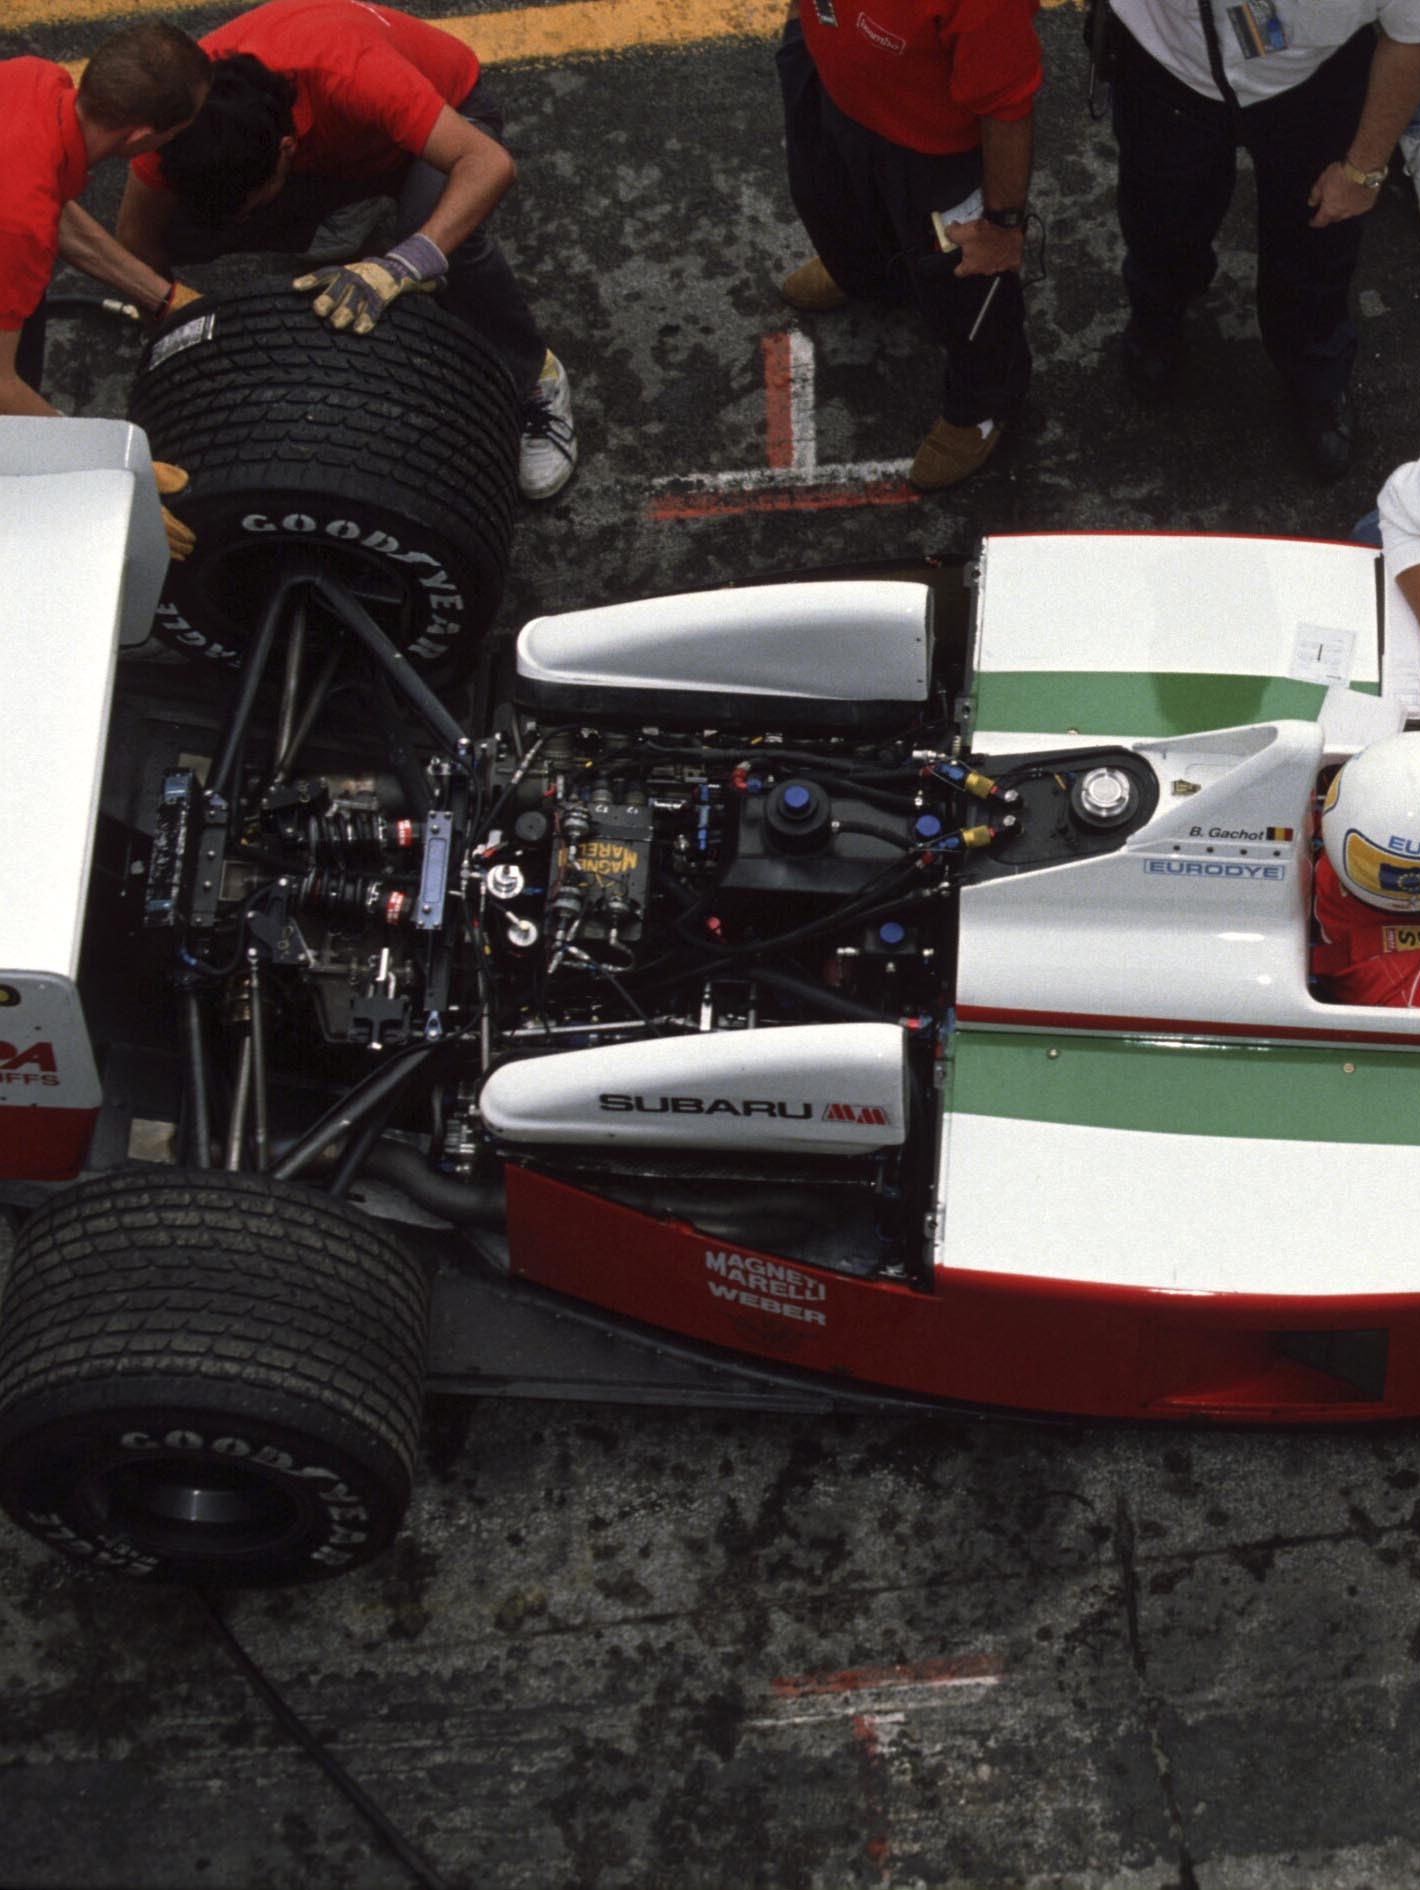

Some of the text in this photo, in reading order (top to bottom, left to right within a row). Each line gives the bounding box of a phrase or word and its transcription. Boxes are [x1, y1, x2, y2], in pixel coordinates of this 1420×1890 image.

[1189, 826, 1265, 841] B. Gachot
[1150, 860, 1281, 880] EURODYE
[0, 1072, 60, 1087] FFS
[599, 1093, 813, 1120] SUBARU
[707, 1281, 827, 1326] WEBER
